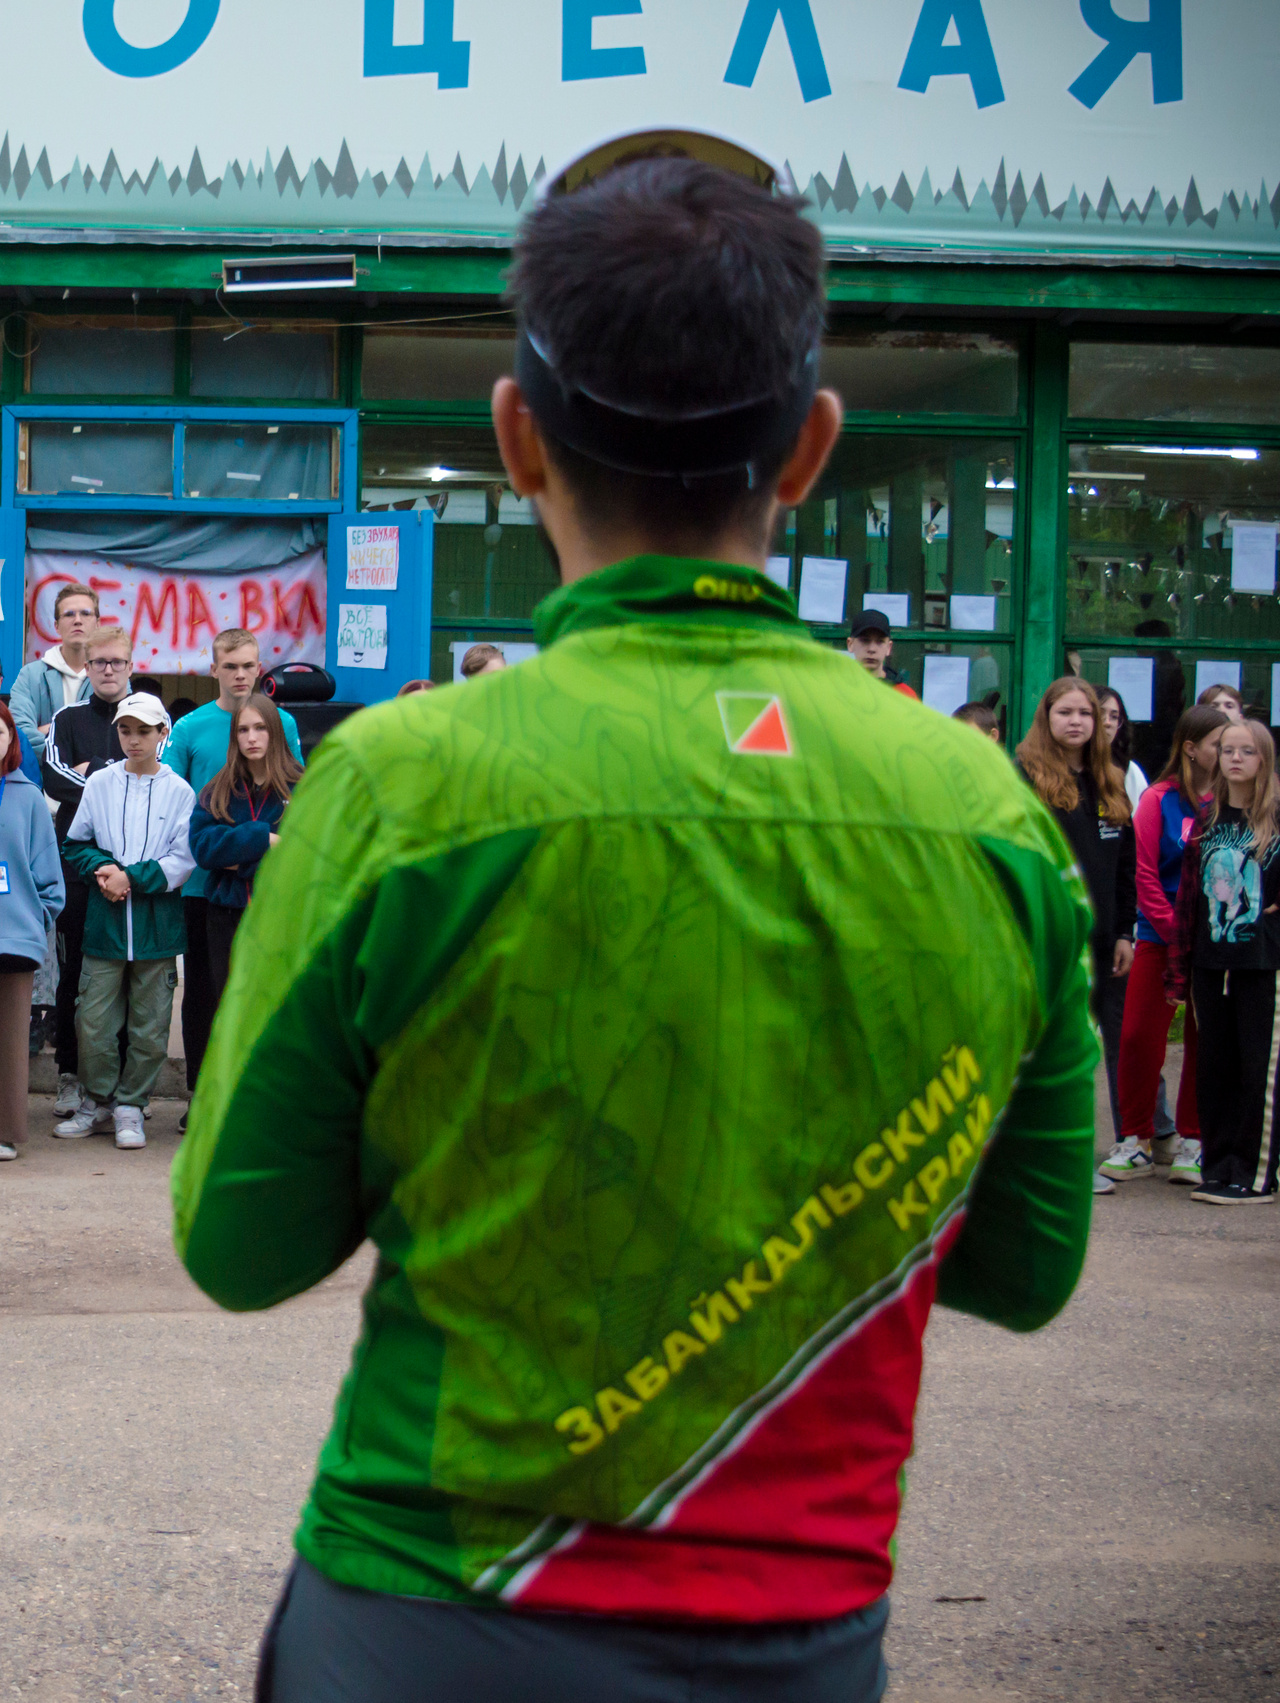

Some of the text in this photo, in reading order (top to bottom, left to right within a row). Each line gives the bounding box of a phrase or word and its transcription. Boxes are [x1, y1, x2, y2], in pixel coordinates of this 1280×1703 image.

[362, 0, 1184, 110] ЦЕЛАЯ
[350, 548, 394, 566] НИЧЕГО
[888, 1093, 992, 1230] КРАЙ
[555, 1045, 980, 1454] ЗАБАЙКАЛЬСКИЙ
